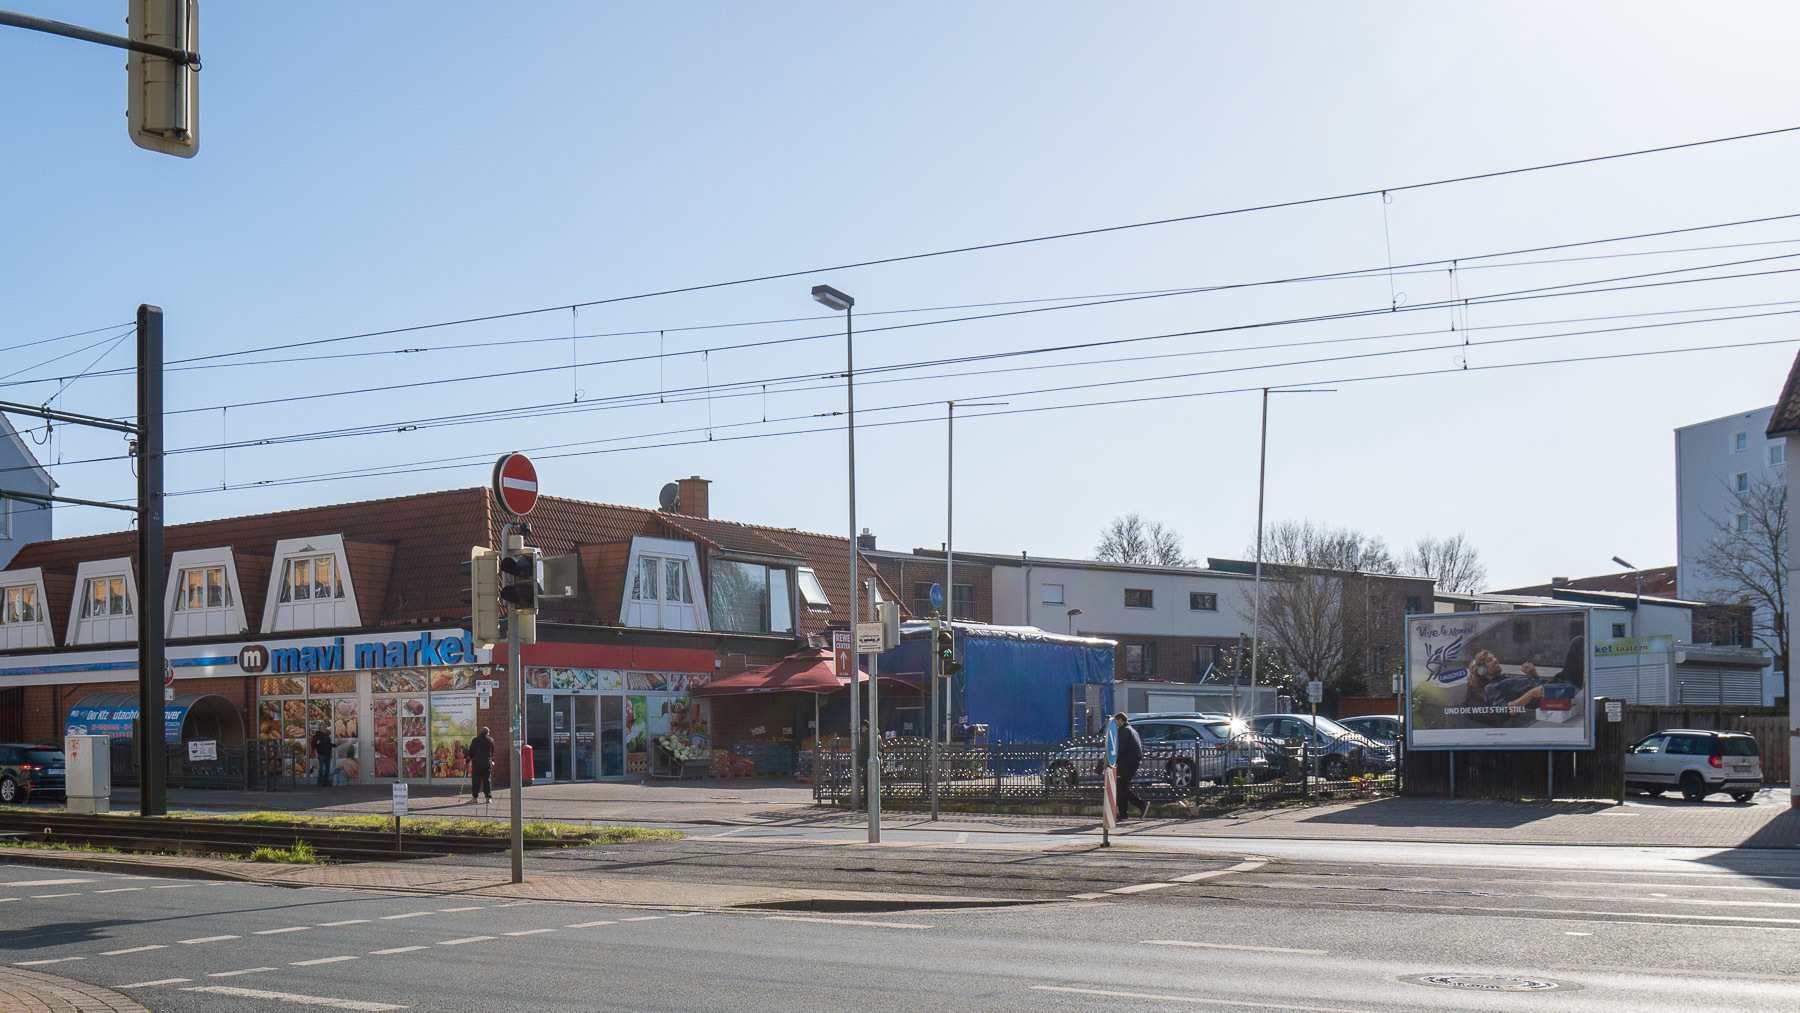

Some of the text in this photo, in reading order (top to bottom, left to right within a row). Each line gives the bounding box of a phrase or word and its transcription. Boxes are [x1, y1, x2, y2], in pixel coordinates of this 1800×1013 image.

[1416, 626, 1440, 639] Vive
[1440, 625, 1448, 637] le
[836, 633, 851, 643] REWE
[271, 637, 345, 673] mavi
[355, 630, 477, 669] market
[1594, 644, 1612, 654] ket
[86, 710, 98, 720] Der
[97, 709, 109, 720] Kfz
[1444, 706, 1460, 715] UND
[1460, 706, 1471, 714] DIE
[1471, 705, 1489, 714] WELT
[1509, 705, 1527, 713] STILL
